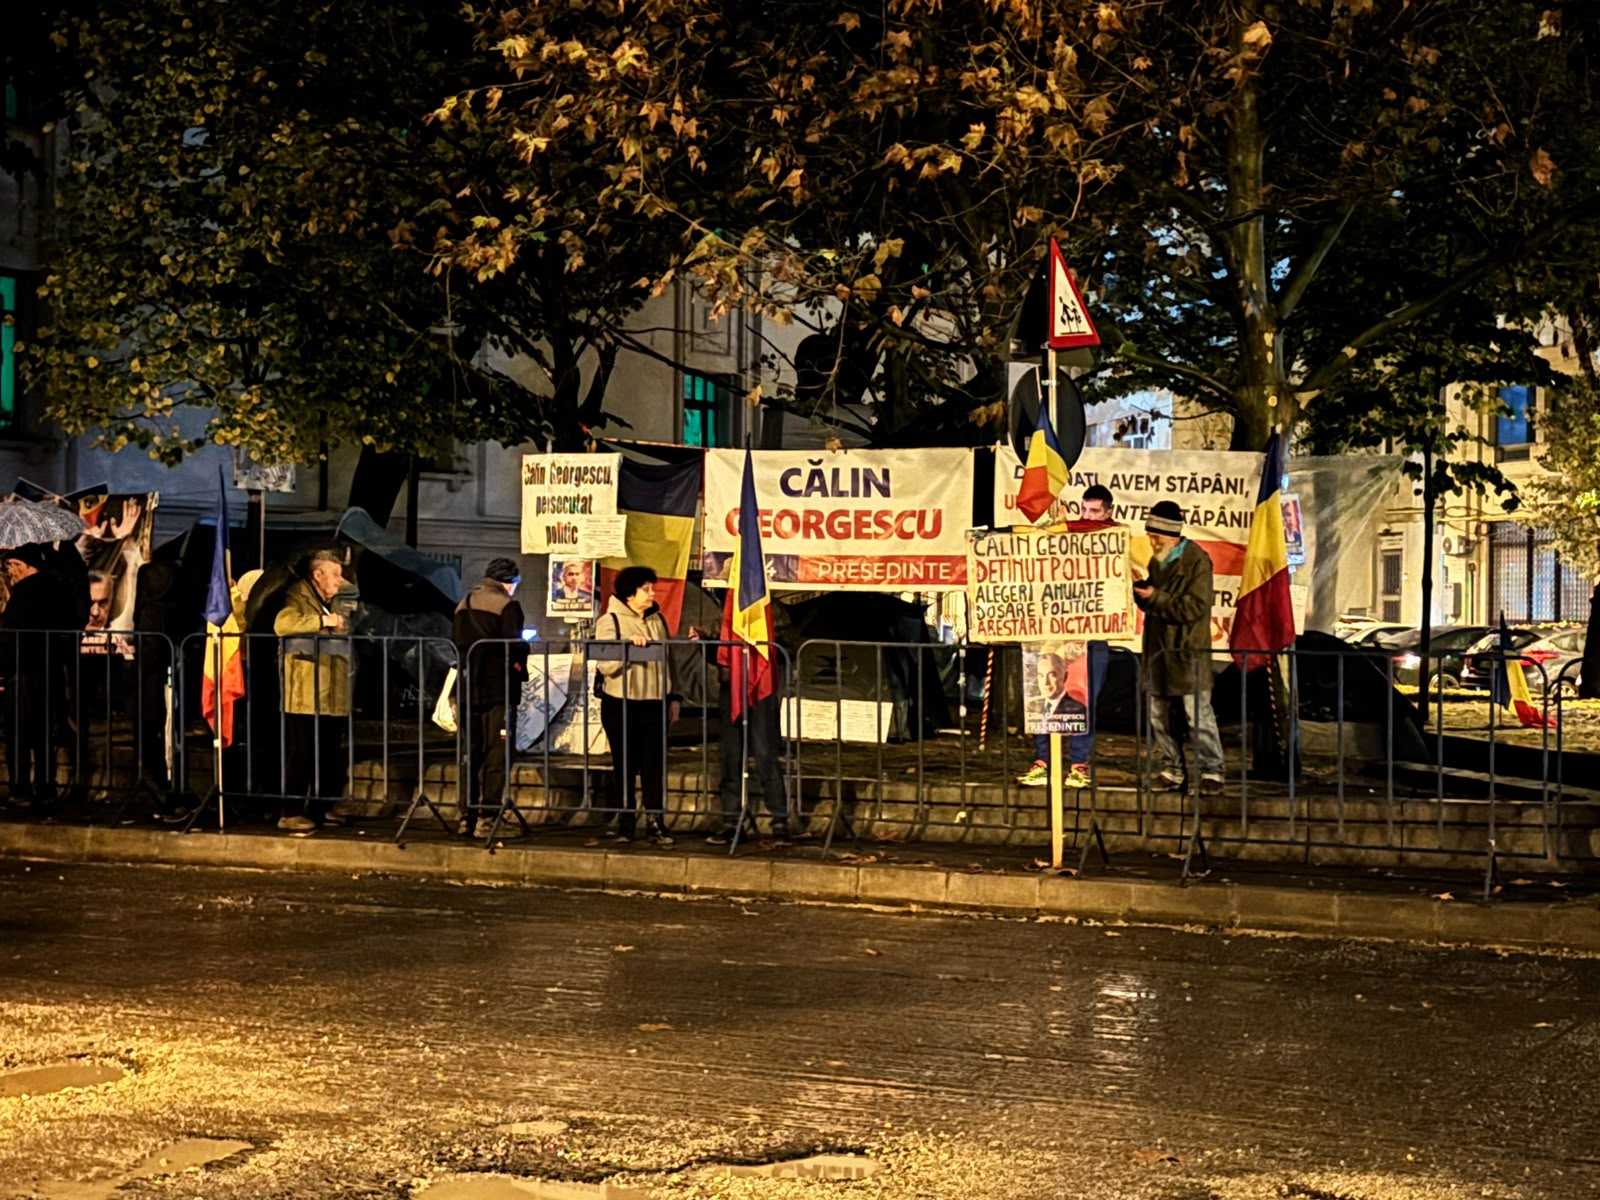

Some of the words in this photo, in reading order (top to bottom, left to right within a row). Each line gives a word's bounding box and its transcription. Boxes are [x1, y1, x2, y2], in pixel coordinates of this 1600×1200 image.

[779, 458, 891, 497] CĂLIN
[1110, 473, 1161, 492] AVEM
[1166, 472, 1250, 498] STĂPÂNI,
[1036, 532, 1125, 556] GEORGESCU
[1050, 555, 1122, 582] POLITIC
[976, 583, 1033, 603] ALEGERI
[976, 601, 1036, 620] DOSARE
[1042, 598, 1105, 617] POLITICE
